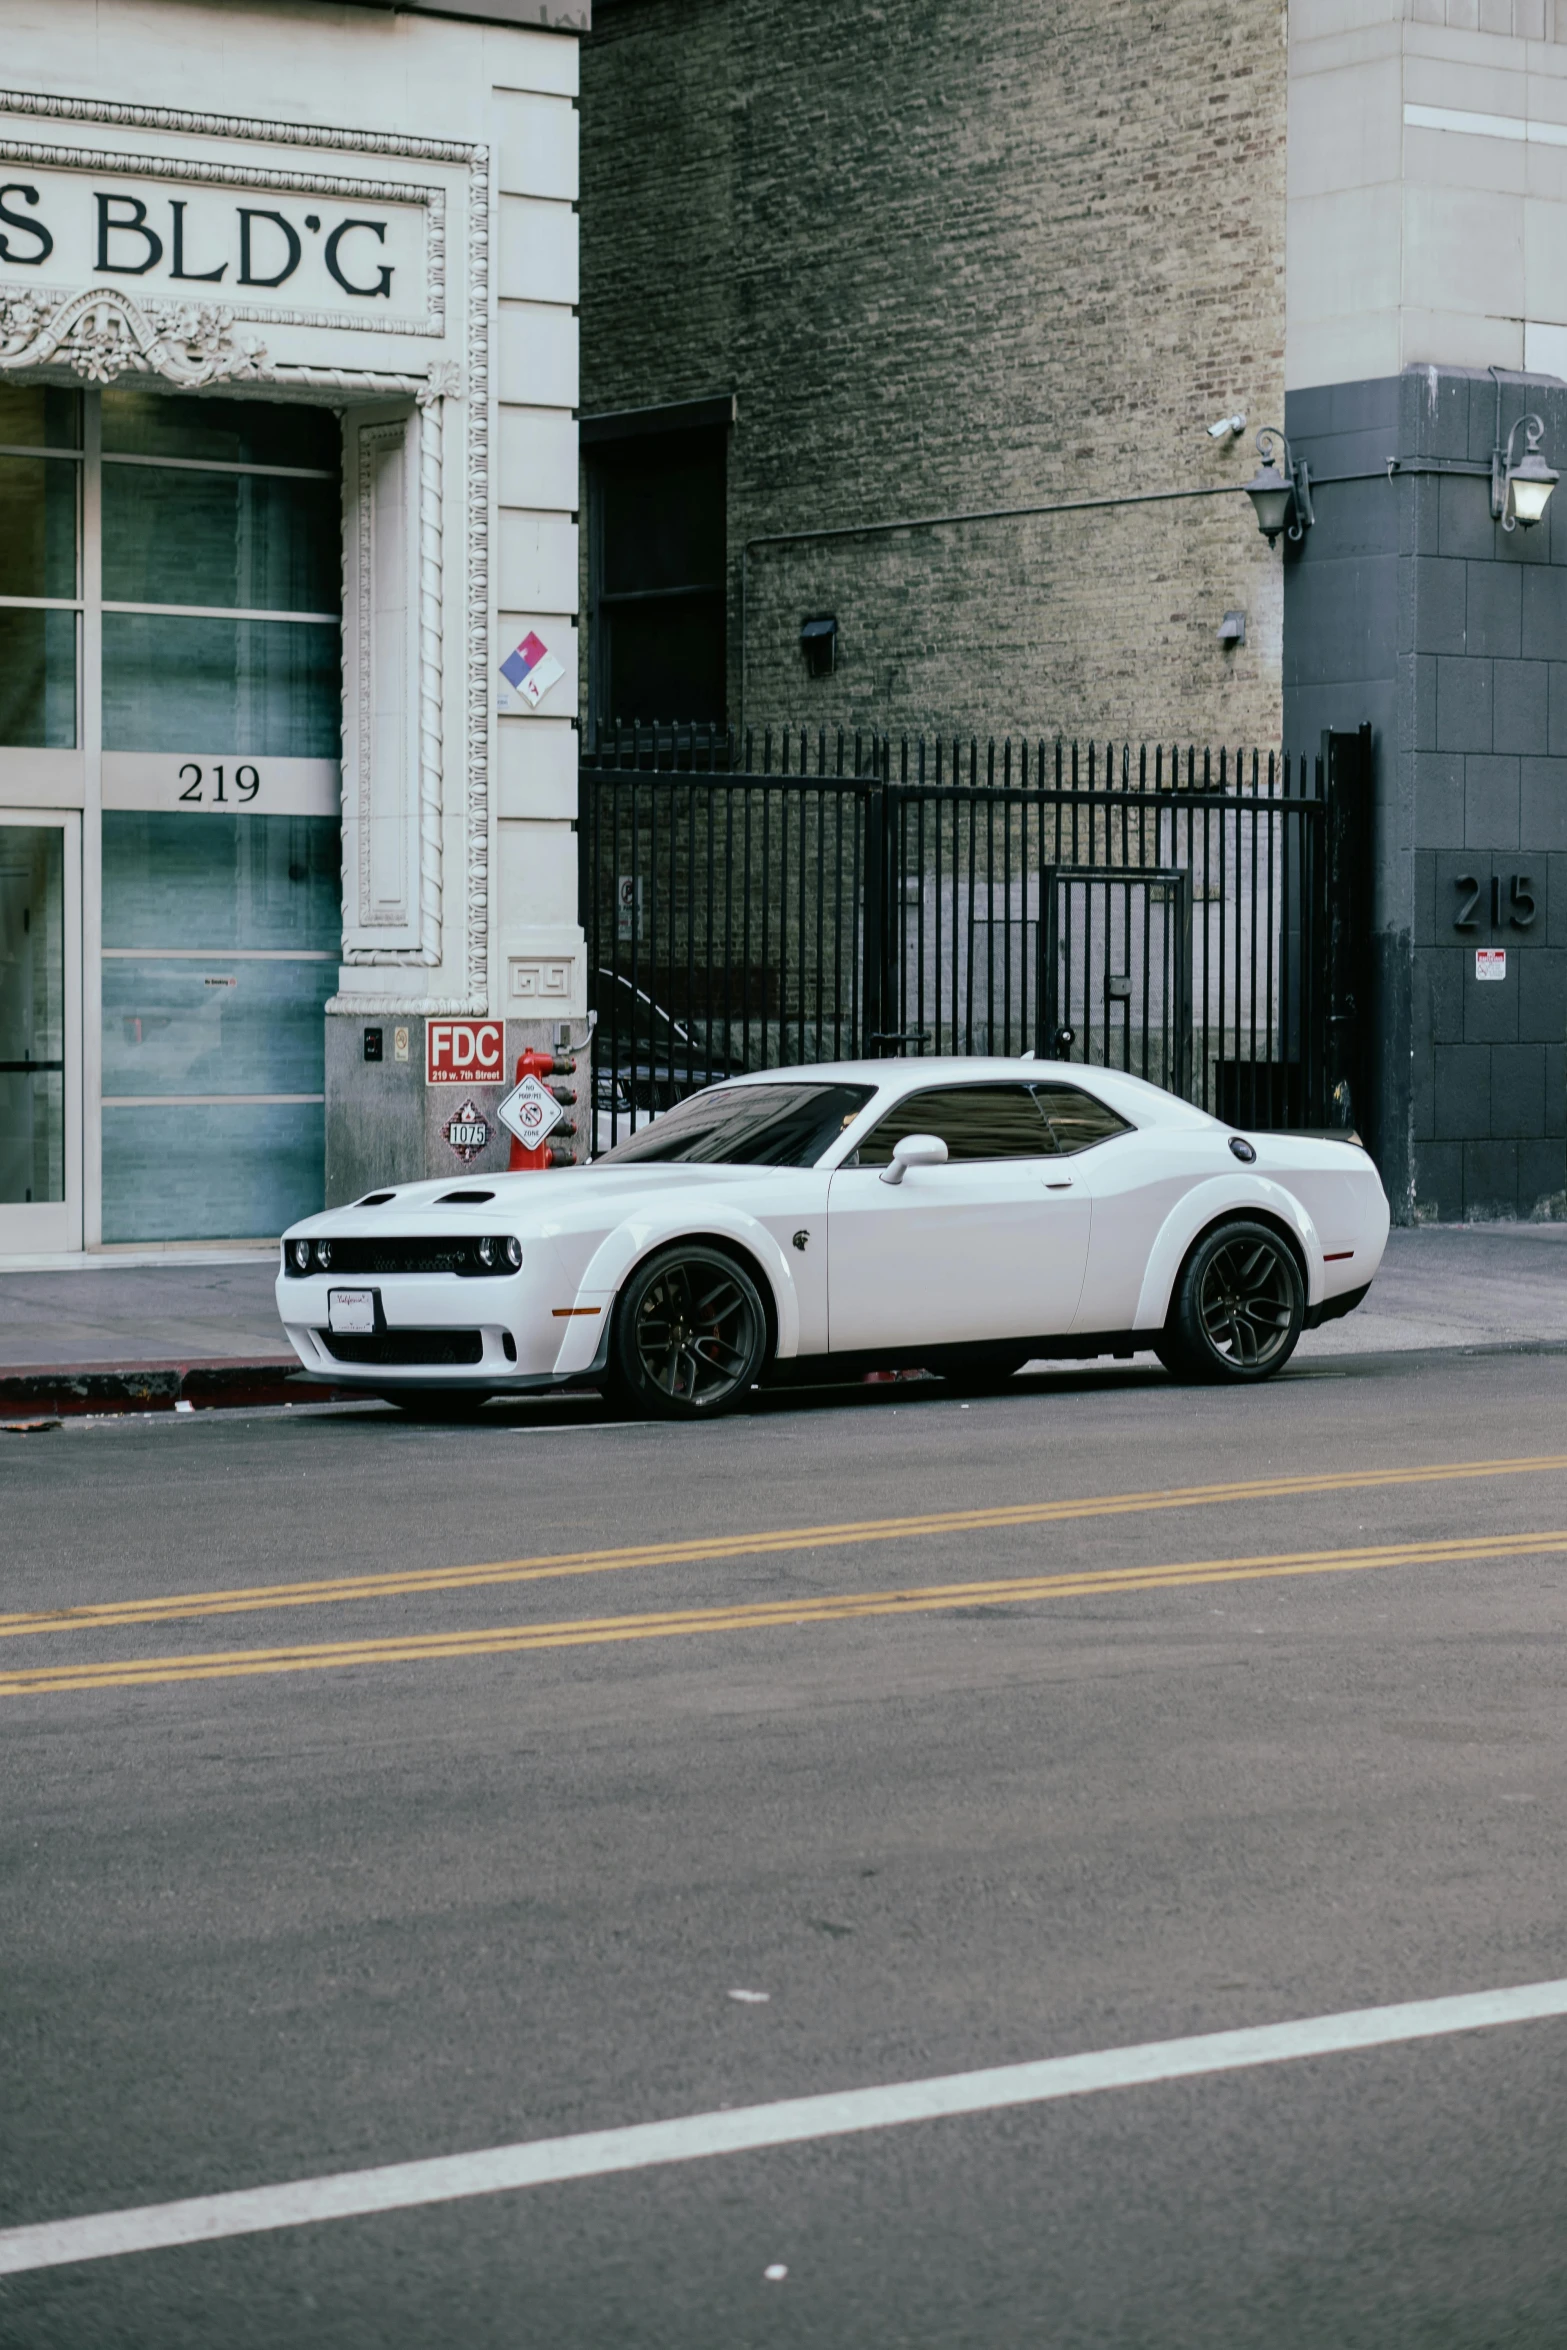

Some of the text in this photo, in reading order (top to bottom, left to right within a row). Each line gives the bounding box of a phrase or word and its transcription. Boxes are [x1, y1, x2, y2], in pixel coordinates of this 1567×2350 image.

[93, 192, 396, 299] BLD'G
[178, 763, 260, 803] 219
[1453, 874, 1537, 930] 215
[432, 1025, 500, 1067] FDC
[432, 1070, 447, 1080] 219
[460, 1070, 473, 1080] 7th
[475, 1070, 500, 1080] Street
[518, 1092, 541, 1100] POOP/PEE
[452, 1126, 484, 1143] 1075
